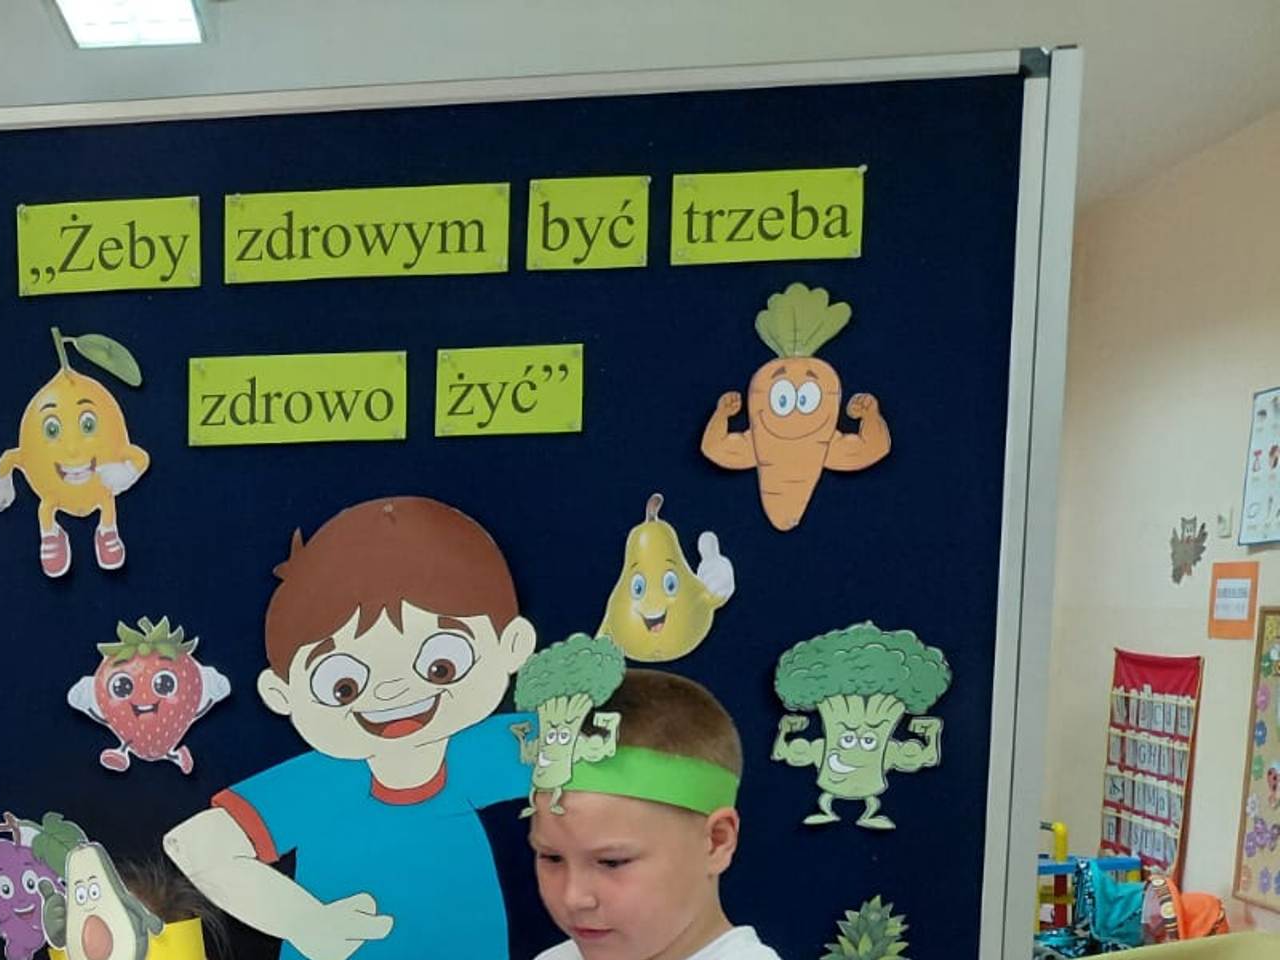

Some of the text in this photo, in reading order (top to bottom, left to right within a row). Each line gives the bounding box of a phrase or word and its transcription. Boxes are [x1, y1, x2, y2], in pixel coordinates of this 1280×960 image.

[235, 211, 487, 270] zdrowym
[539, 200, 636, 265] być
[683, 190, 853, 245] trzeba
[200, 376, 394, 427] zdrowo
